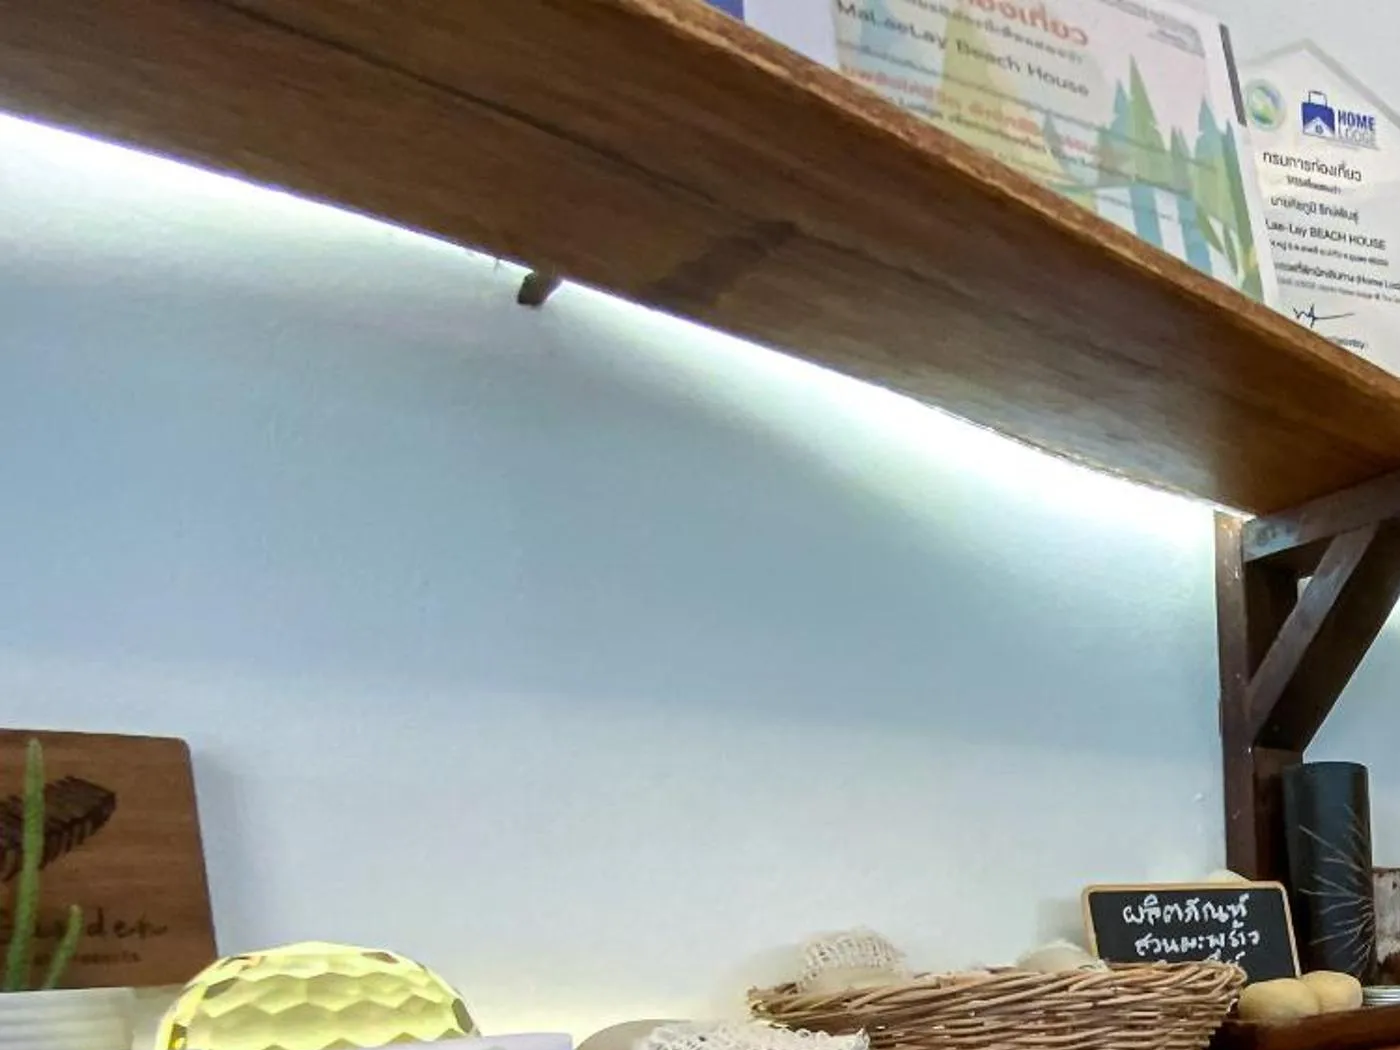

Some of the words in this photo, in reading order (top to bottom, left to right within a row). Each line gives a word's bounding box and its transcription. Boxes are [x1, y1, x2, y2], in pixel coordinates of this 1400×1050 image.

[1026, 62, 1090, 97] House
[1337, 109, 1375, 132] HOME
[1309, 226, 1347, 243] BEACH
[1349, 234, 1387, 251] HOUSE
